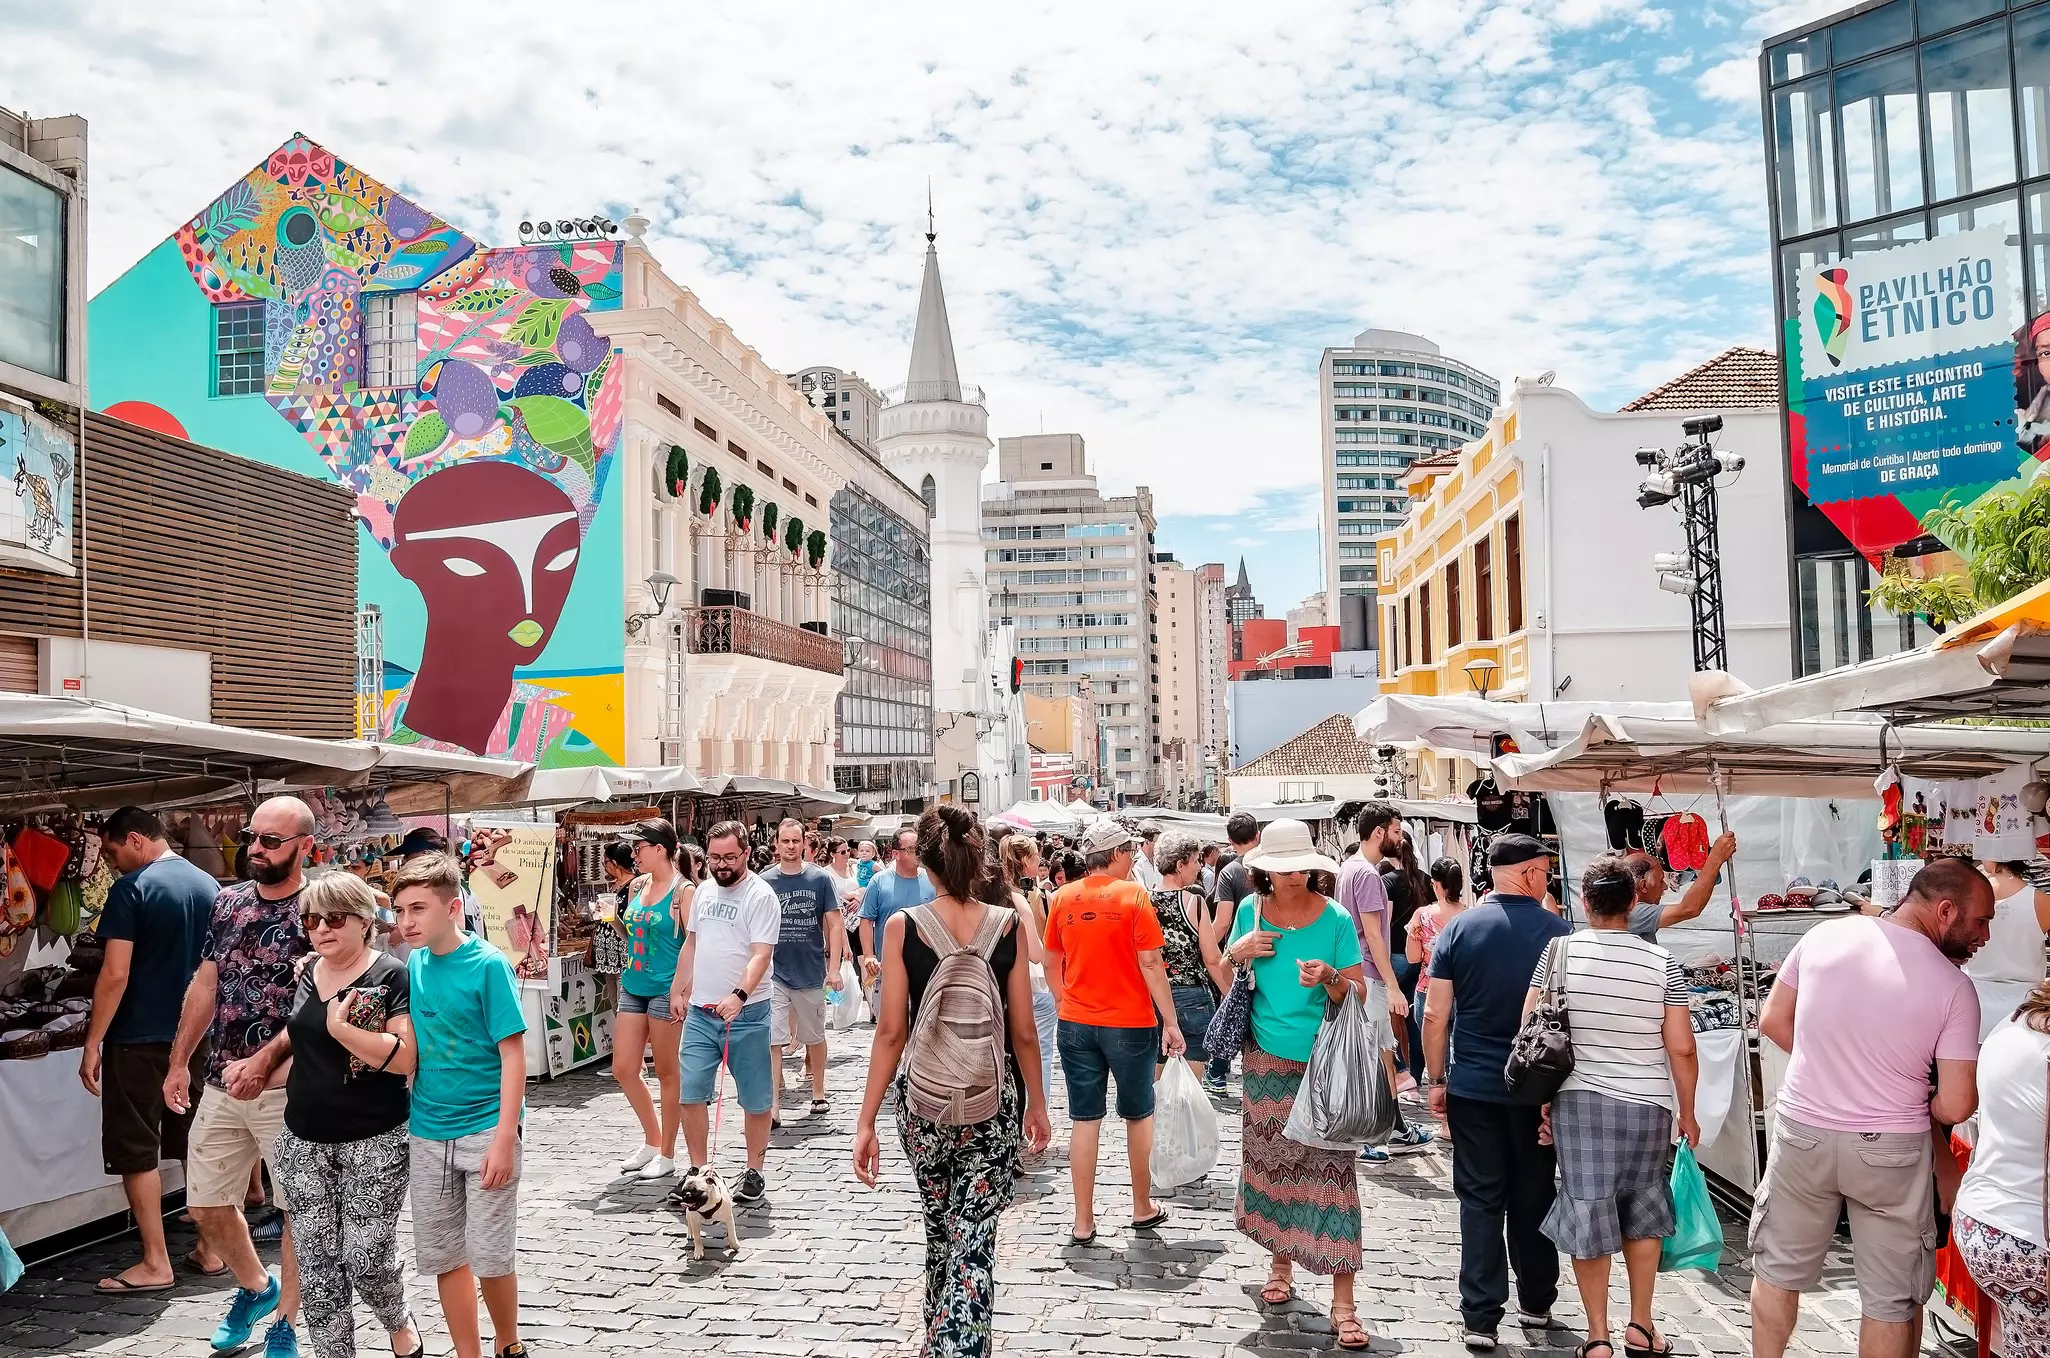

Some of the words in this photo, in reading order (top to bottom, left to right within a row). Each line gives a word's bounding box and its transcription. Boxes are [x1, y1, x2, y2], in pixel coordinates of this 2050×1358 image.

[1859, 256, 1992, 309] PAVILHÃO
[1861, 285, 1994, 343] ÉTNICO
[1825, 383, 1865, 402] VISITE
[1869, 376, 1902, 396] ESTE
[1906, 362, 1983, 389] ENCONTRO
[1843, 402, 1861, 417] DE
[1864, 390, 1928, 414] CULTURA,
[1932, 384, 1967, 403] ARTE
[1866, 417, 1875, 431] E
[1879, 406, 1948, 429] HISTÓRIA.
[1822, 459, 1859, 475] Memorial
[1860, 458, 1871, 469] de
[1873, 454, 1905, 468] Curitiba
[1912, 449, 1940, 462] Aberto
[1942, 444, 1962, 457] todo
[1963, 440, 2002, 456] domingo
[1880, 470, 1896, 483] DE
[1899, 463, 1939, 480] GRAÇA
[503, 847, 541, 857] descascador
[514, 837, 521, 845] O
[792, 889, 817, 901] EDITION
